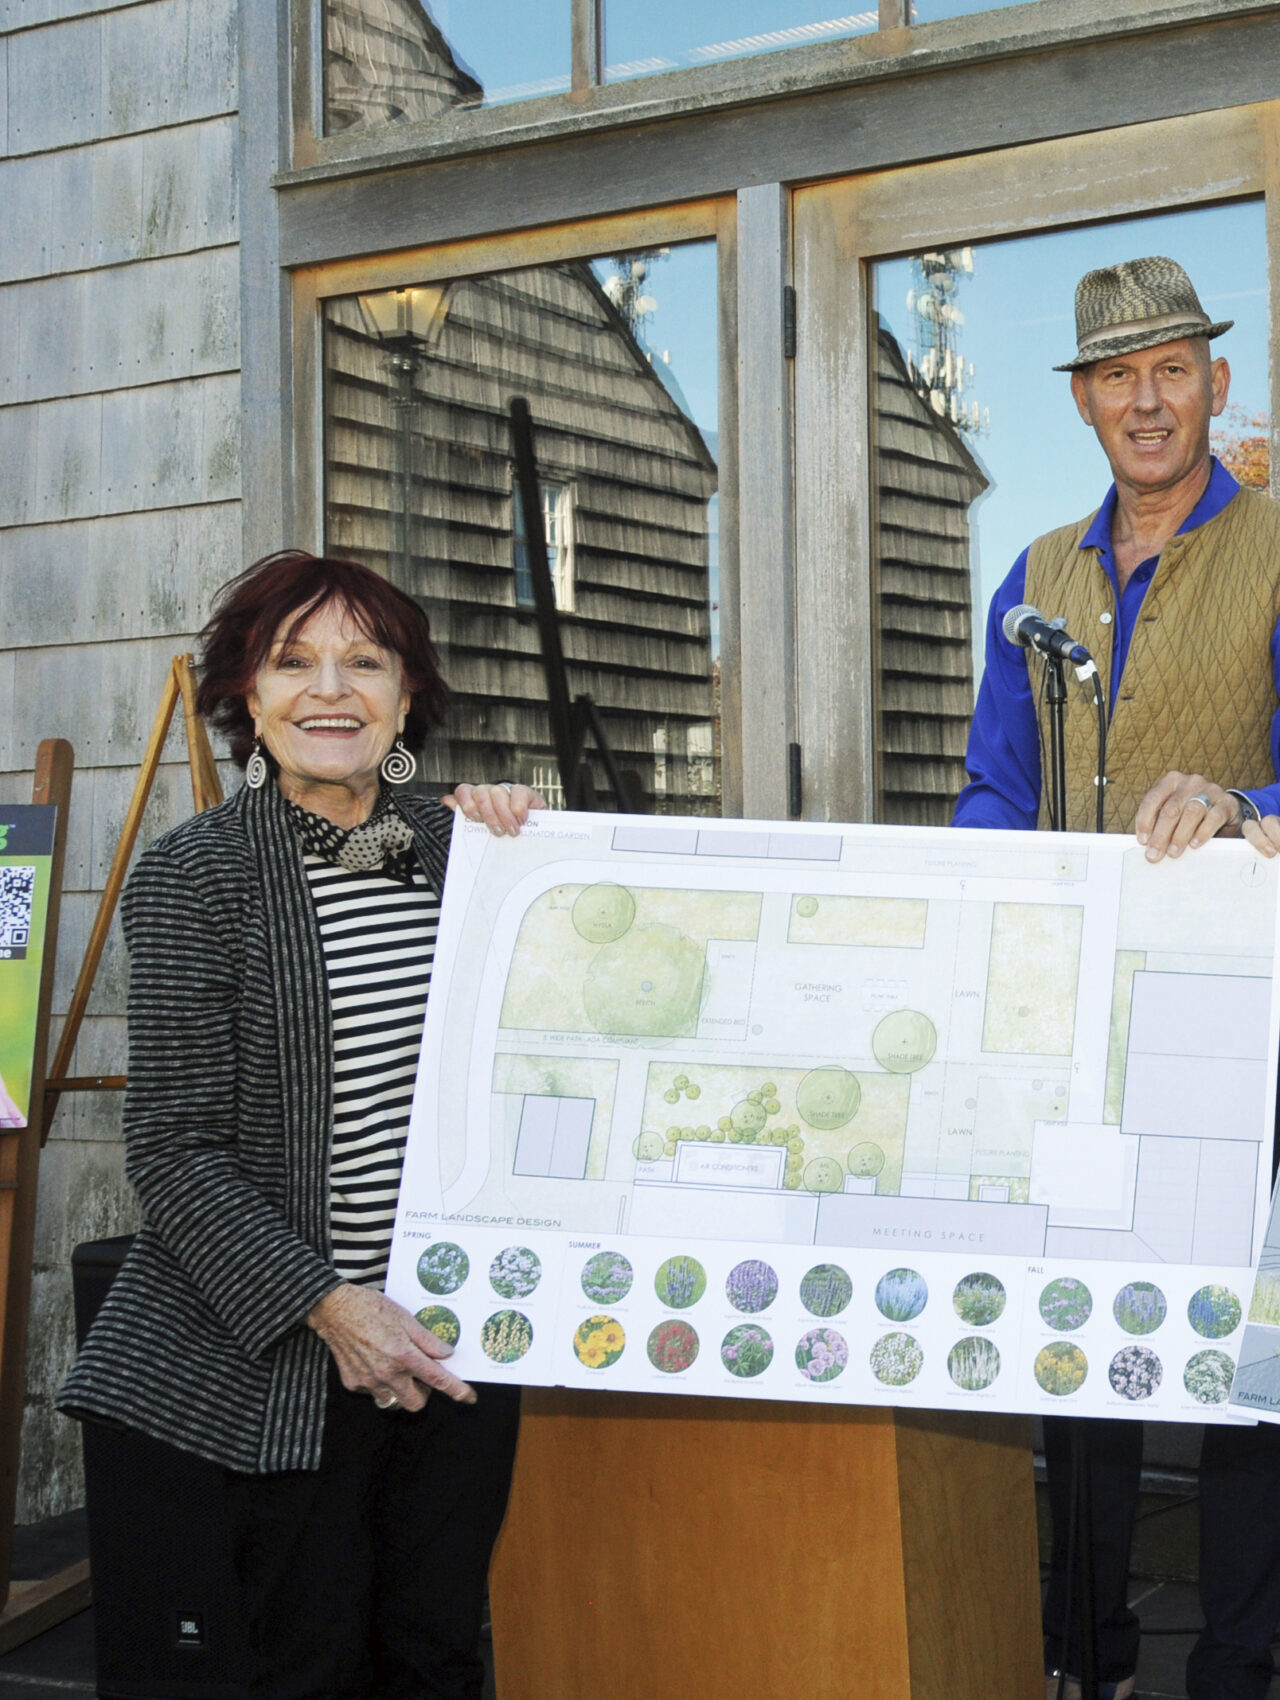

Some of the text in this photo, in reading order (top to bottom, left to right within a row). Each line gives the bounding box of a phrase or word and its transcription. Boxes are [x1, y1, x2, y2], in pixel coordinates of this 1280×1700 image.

[557, 831, 591, 840] GARDEN
[794, 983, 843, 993] GATHERING
[954, 989, 980, 998] LAWN
[803, 994, 832, 1003] SPACE
[701, 1017, 732, 1026] EXTENDED
[947, 1128, 972, 1136] LAWN
[405, 1211, 562, 1227] FARM LANDSCAPE DESIGN
[403, 1231, 432, 1240] SPRING
[872, 1227, 985, 1242] MEETING SPACE
[569, 1240, 601, 1249] SUMMER
[1027, 1265, 1044, 1274] FALL
[1238, 1391, 1267, 1402] FARM
[181, 1621, 199, 1633] JBL
